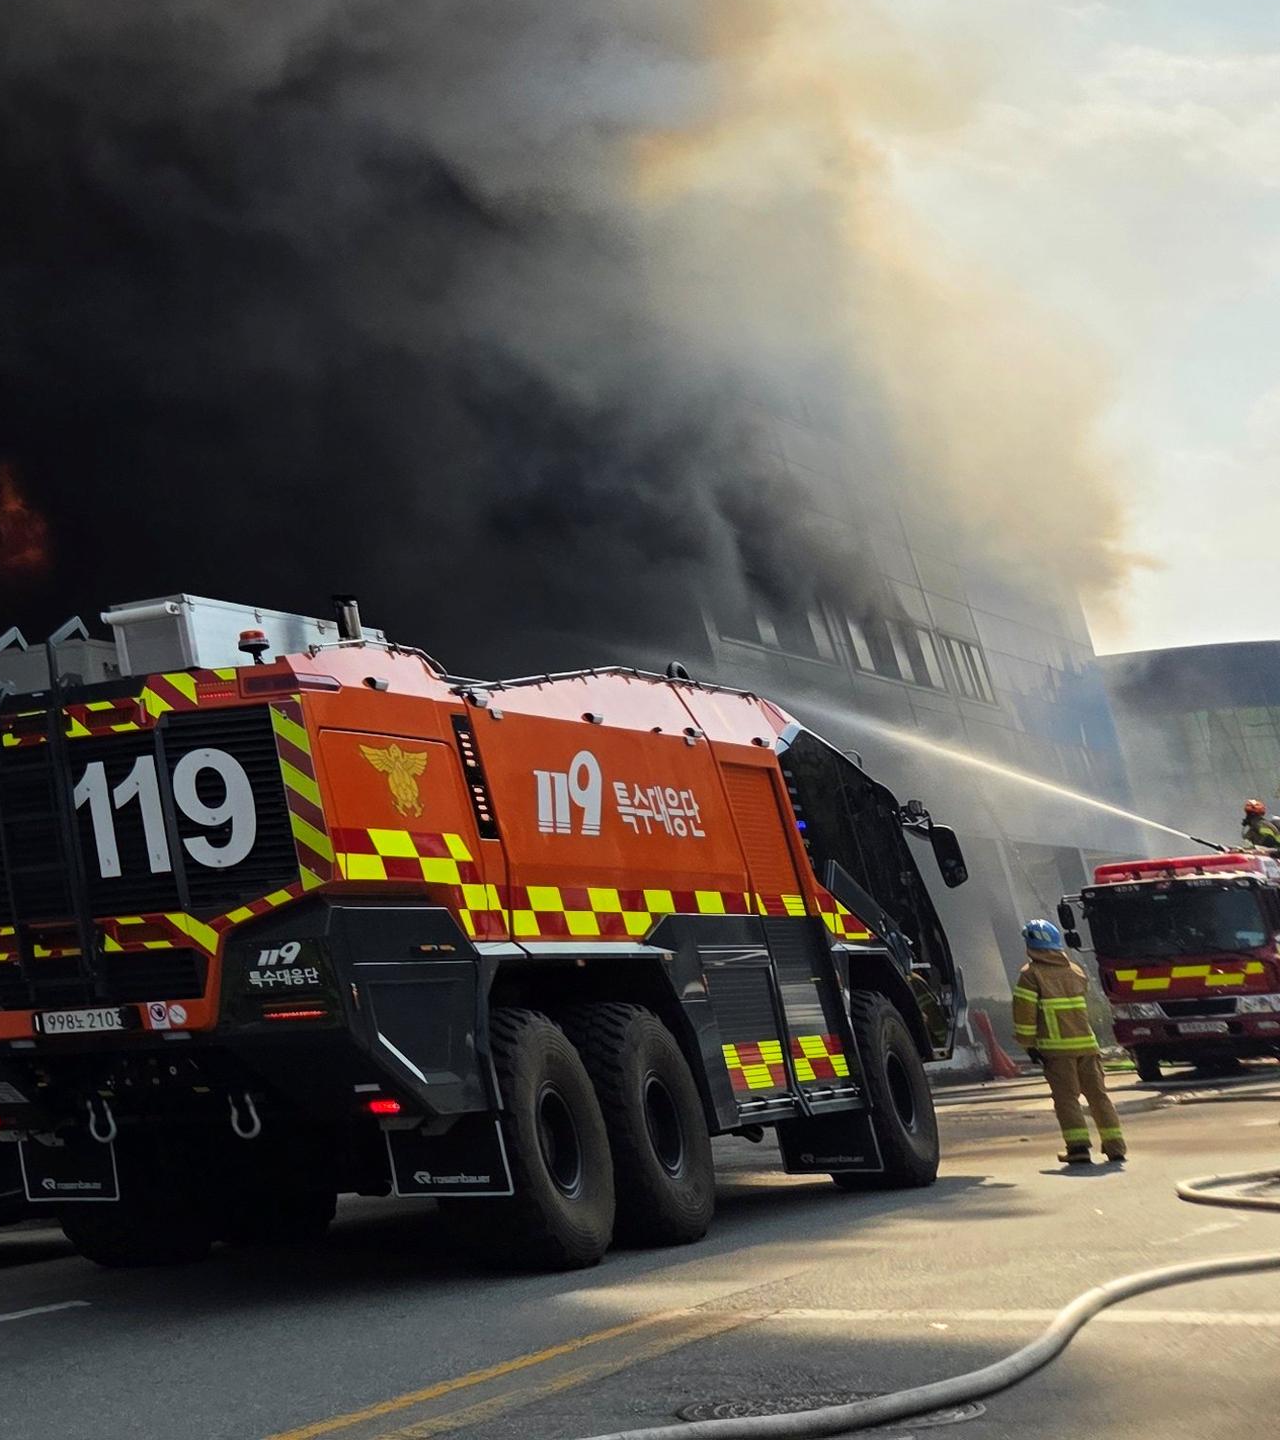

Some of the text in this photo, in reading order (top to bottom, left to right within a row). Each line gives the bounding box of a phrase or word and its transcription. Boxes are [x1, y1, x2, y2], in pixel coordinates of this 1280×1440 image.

[73, 747, 257, 878] 119
[533, 750, 706, 837] 119 특수대응단
[249, 967, 320, 988] 특수대응단
[256, 941, 302, 966] 119
